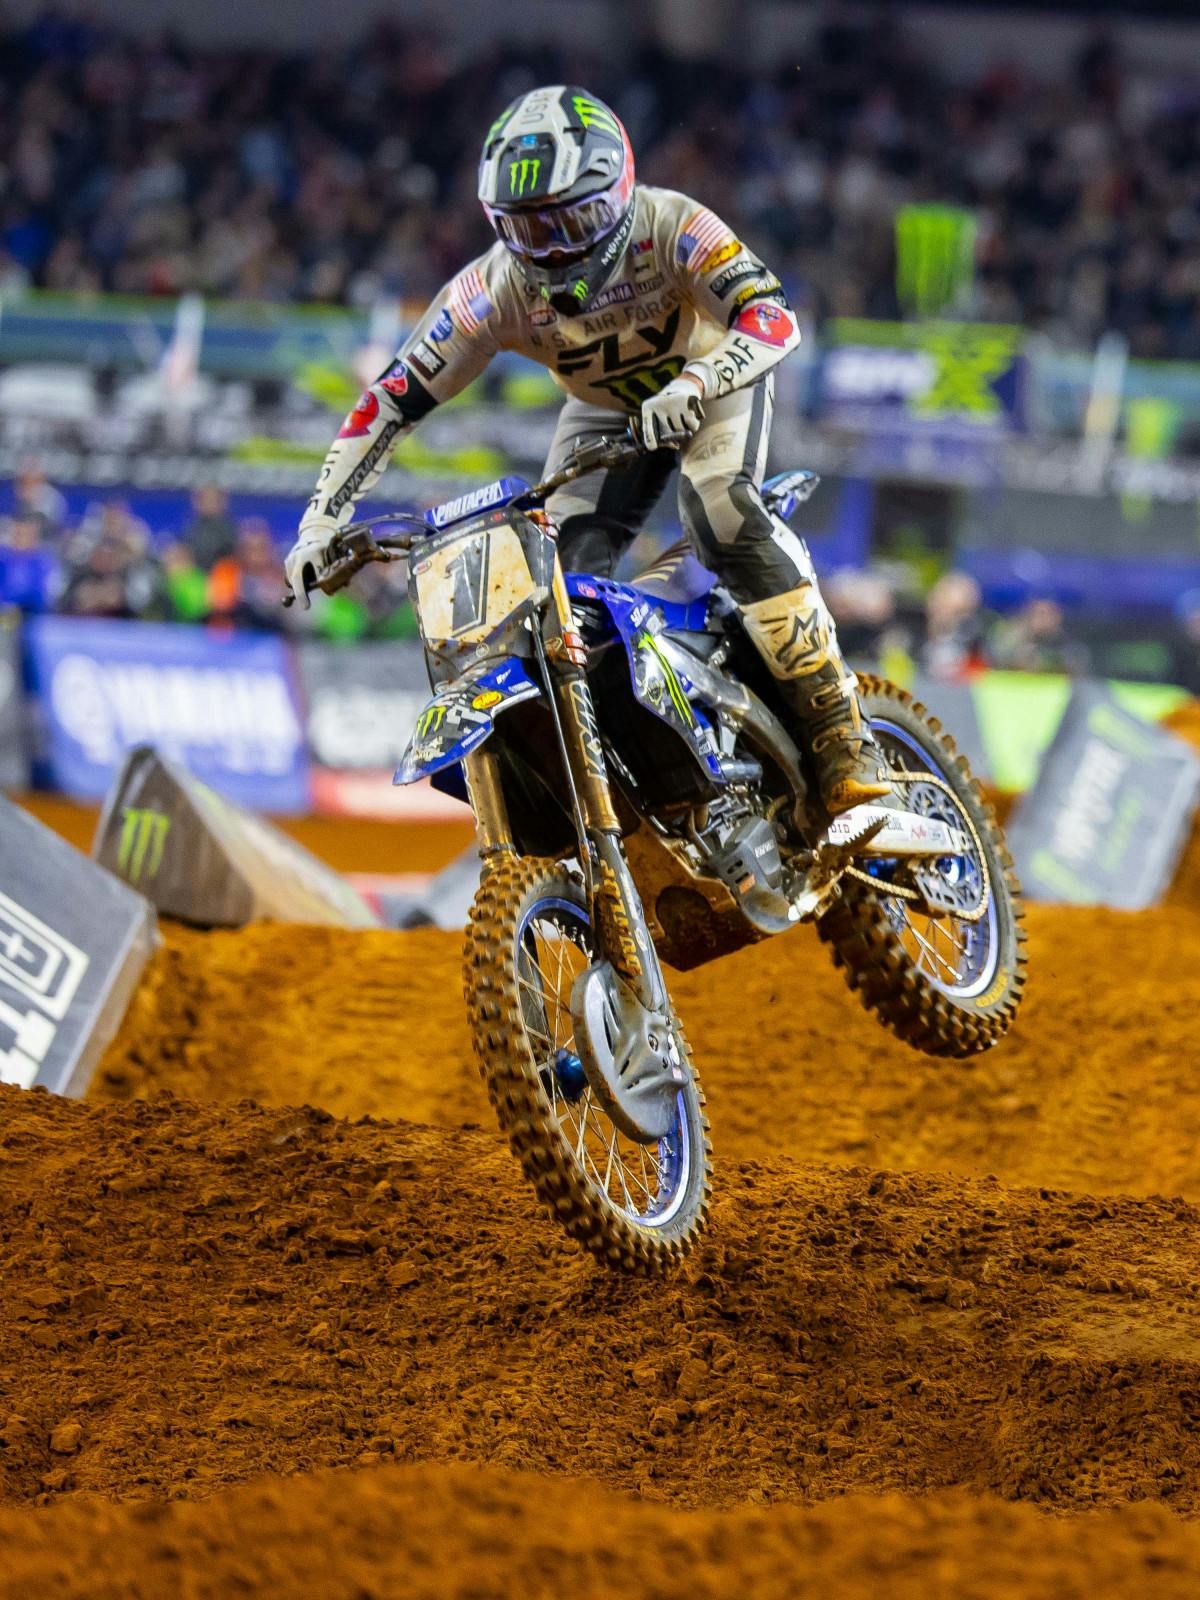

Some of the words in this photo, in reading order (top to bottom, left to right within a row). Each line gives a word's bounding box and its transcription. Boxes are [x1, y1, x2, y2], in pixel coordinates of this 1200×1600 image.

[557, 304, 681, 376] FLY
[583, 313, 618, 337] AIR
[436, 482, 503, 527] PROTAPER
